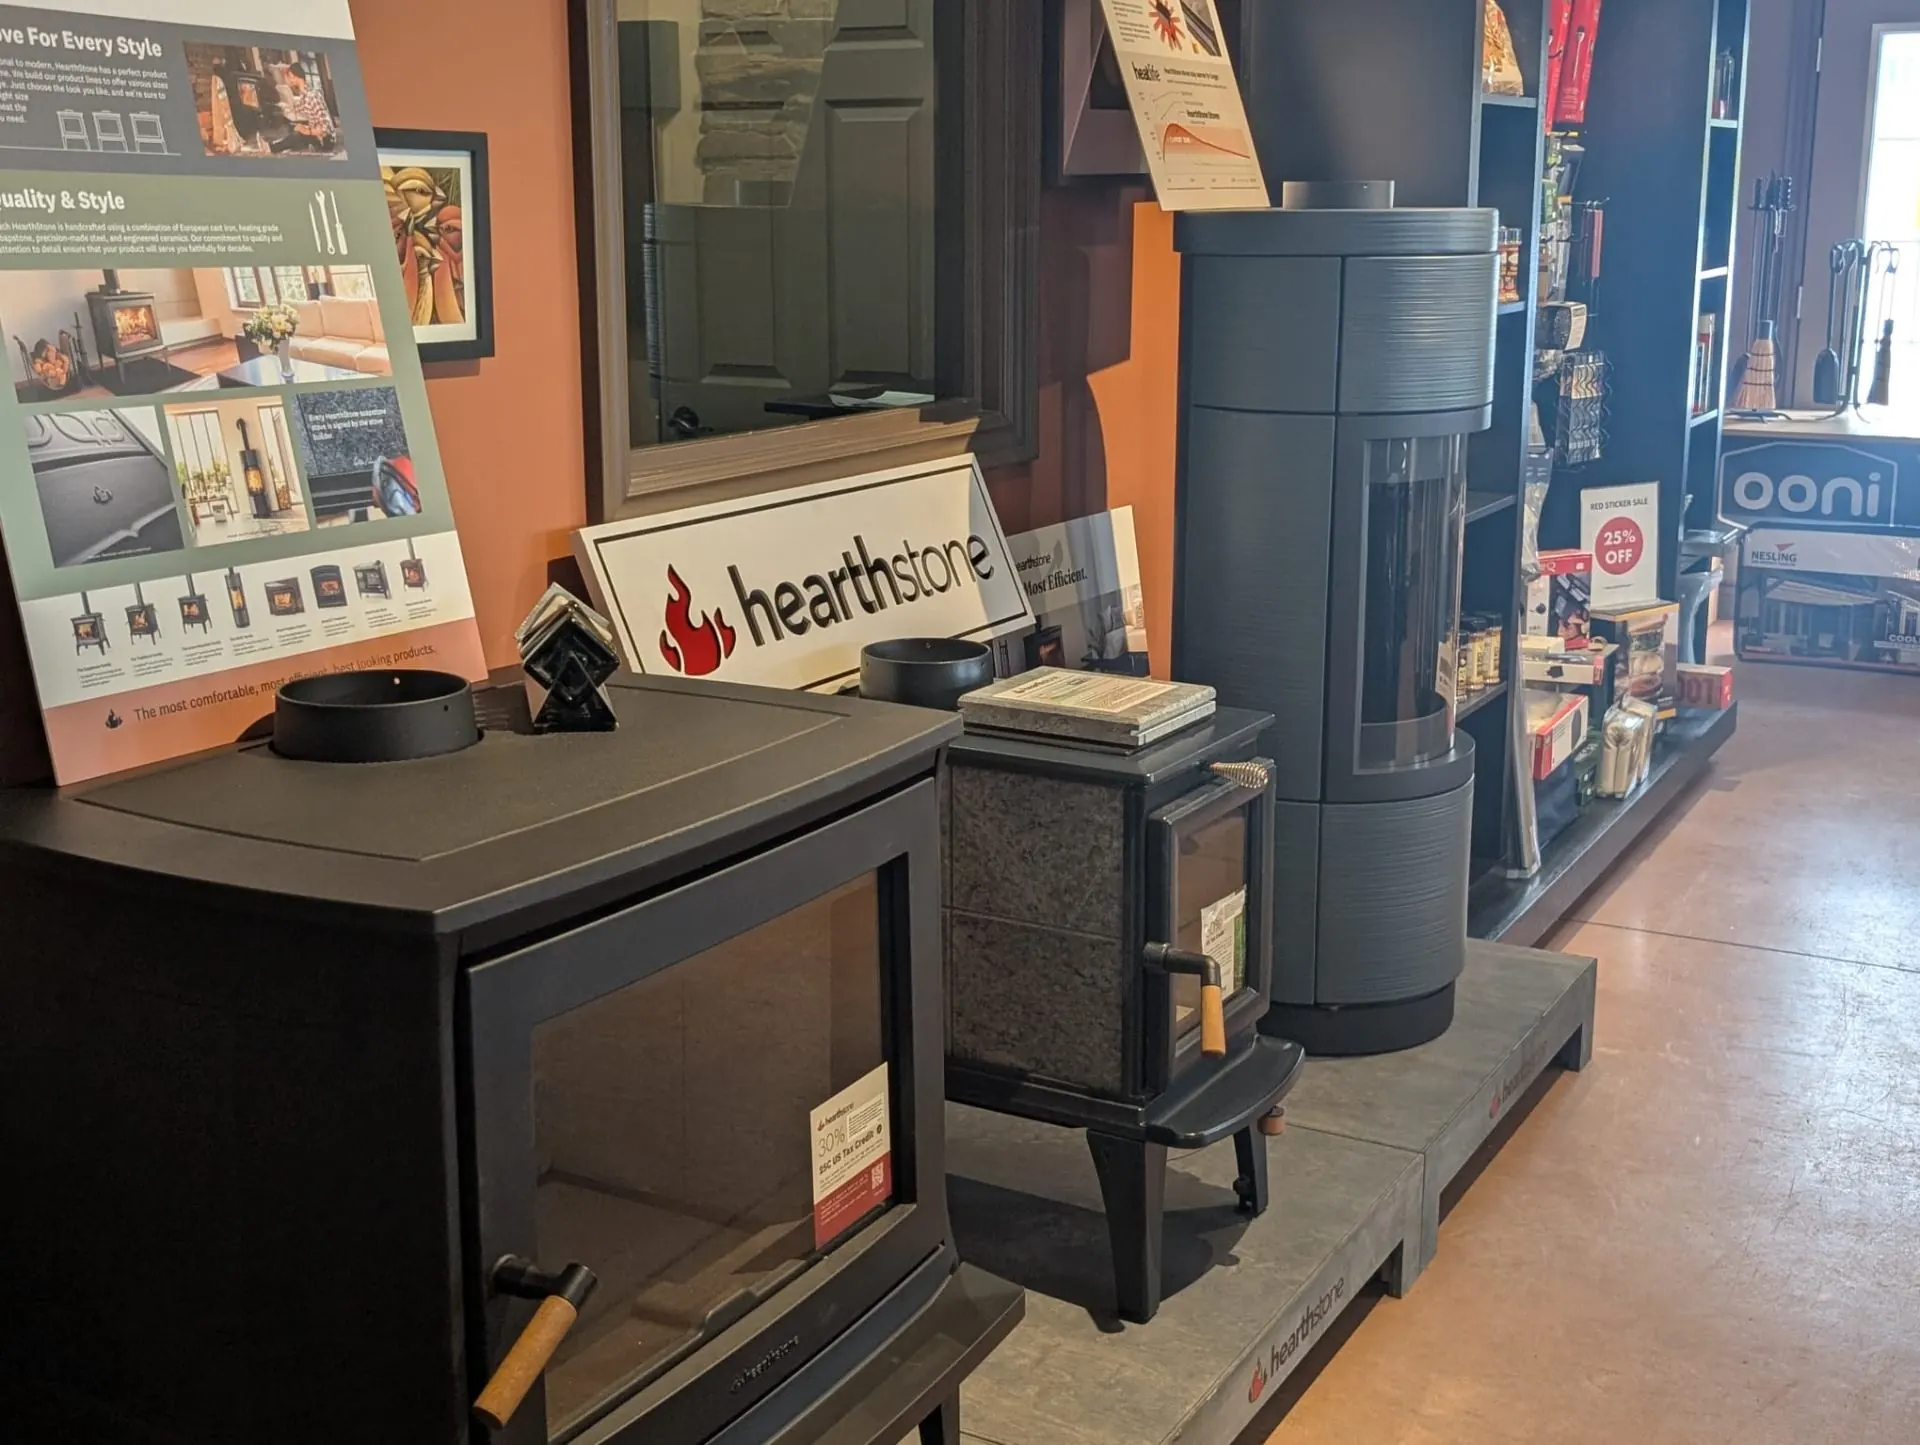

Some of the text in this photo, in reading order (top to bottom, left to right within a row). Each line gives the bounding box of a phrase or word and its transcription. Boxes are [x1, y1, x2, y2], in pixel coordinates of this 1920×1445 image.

[0, 26, 162, 60] ve For Every Style
[0, 188, 125, 214] uality & Style
[1590, 497, 1649, 510] RED STICKER SALE
[1734, 471, 1881, 518] ooni
[1603, 529, 1636, 546] 25%
[1016, 553, 1052, 573] earthstone
[1605, 549, 1633, 564] OFF
[1751, 551, 1798, 562] NESLING
[727, 534, 995, 648] hearthstone
[1023, 566, 1088, 597] Most Efficient.
[133, 707, 158, 722] The
[159, 699, 188, 717] most
[190, 682, 259, 710] comfortable,
[260, 677, 286, 693] most
[393, 644, 437, 665] products.
[819, 1127, 846, 1157] 30%
[1270, 1277, 1345, 1378] hearthstone
